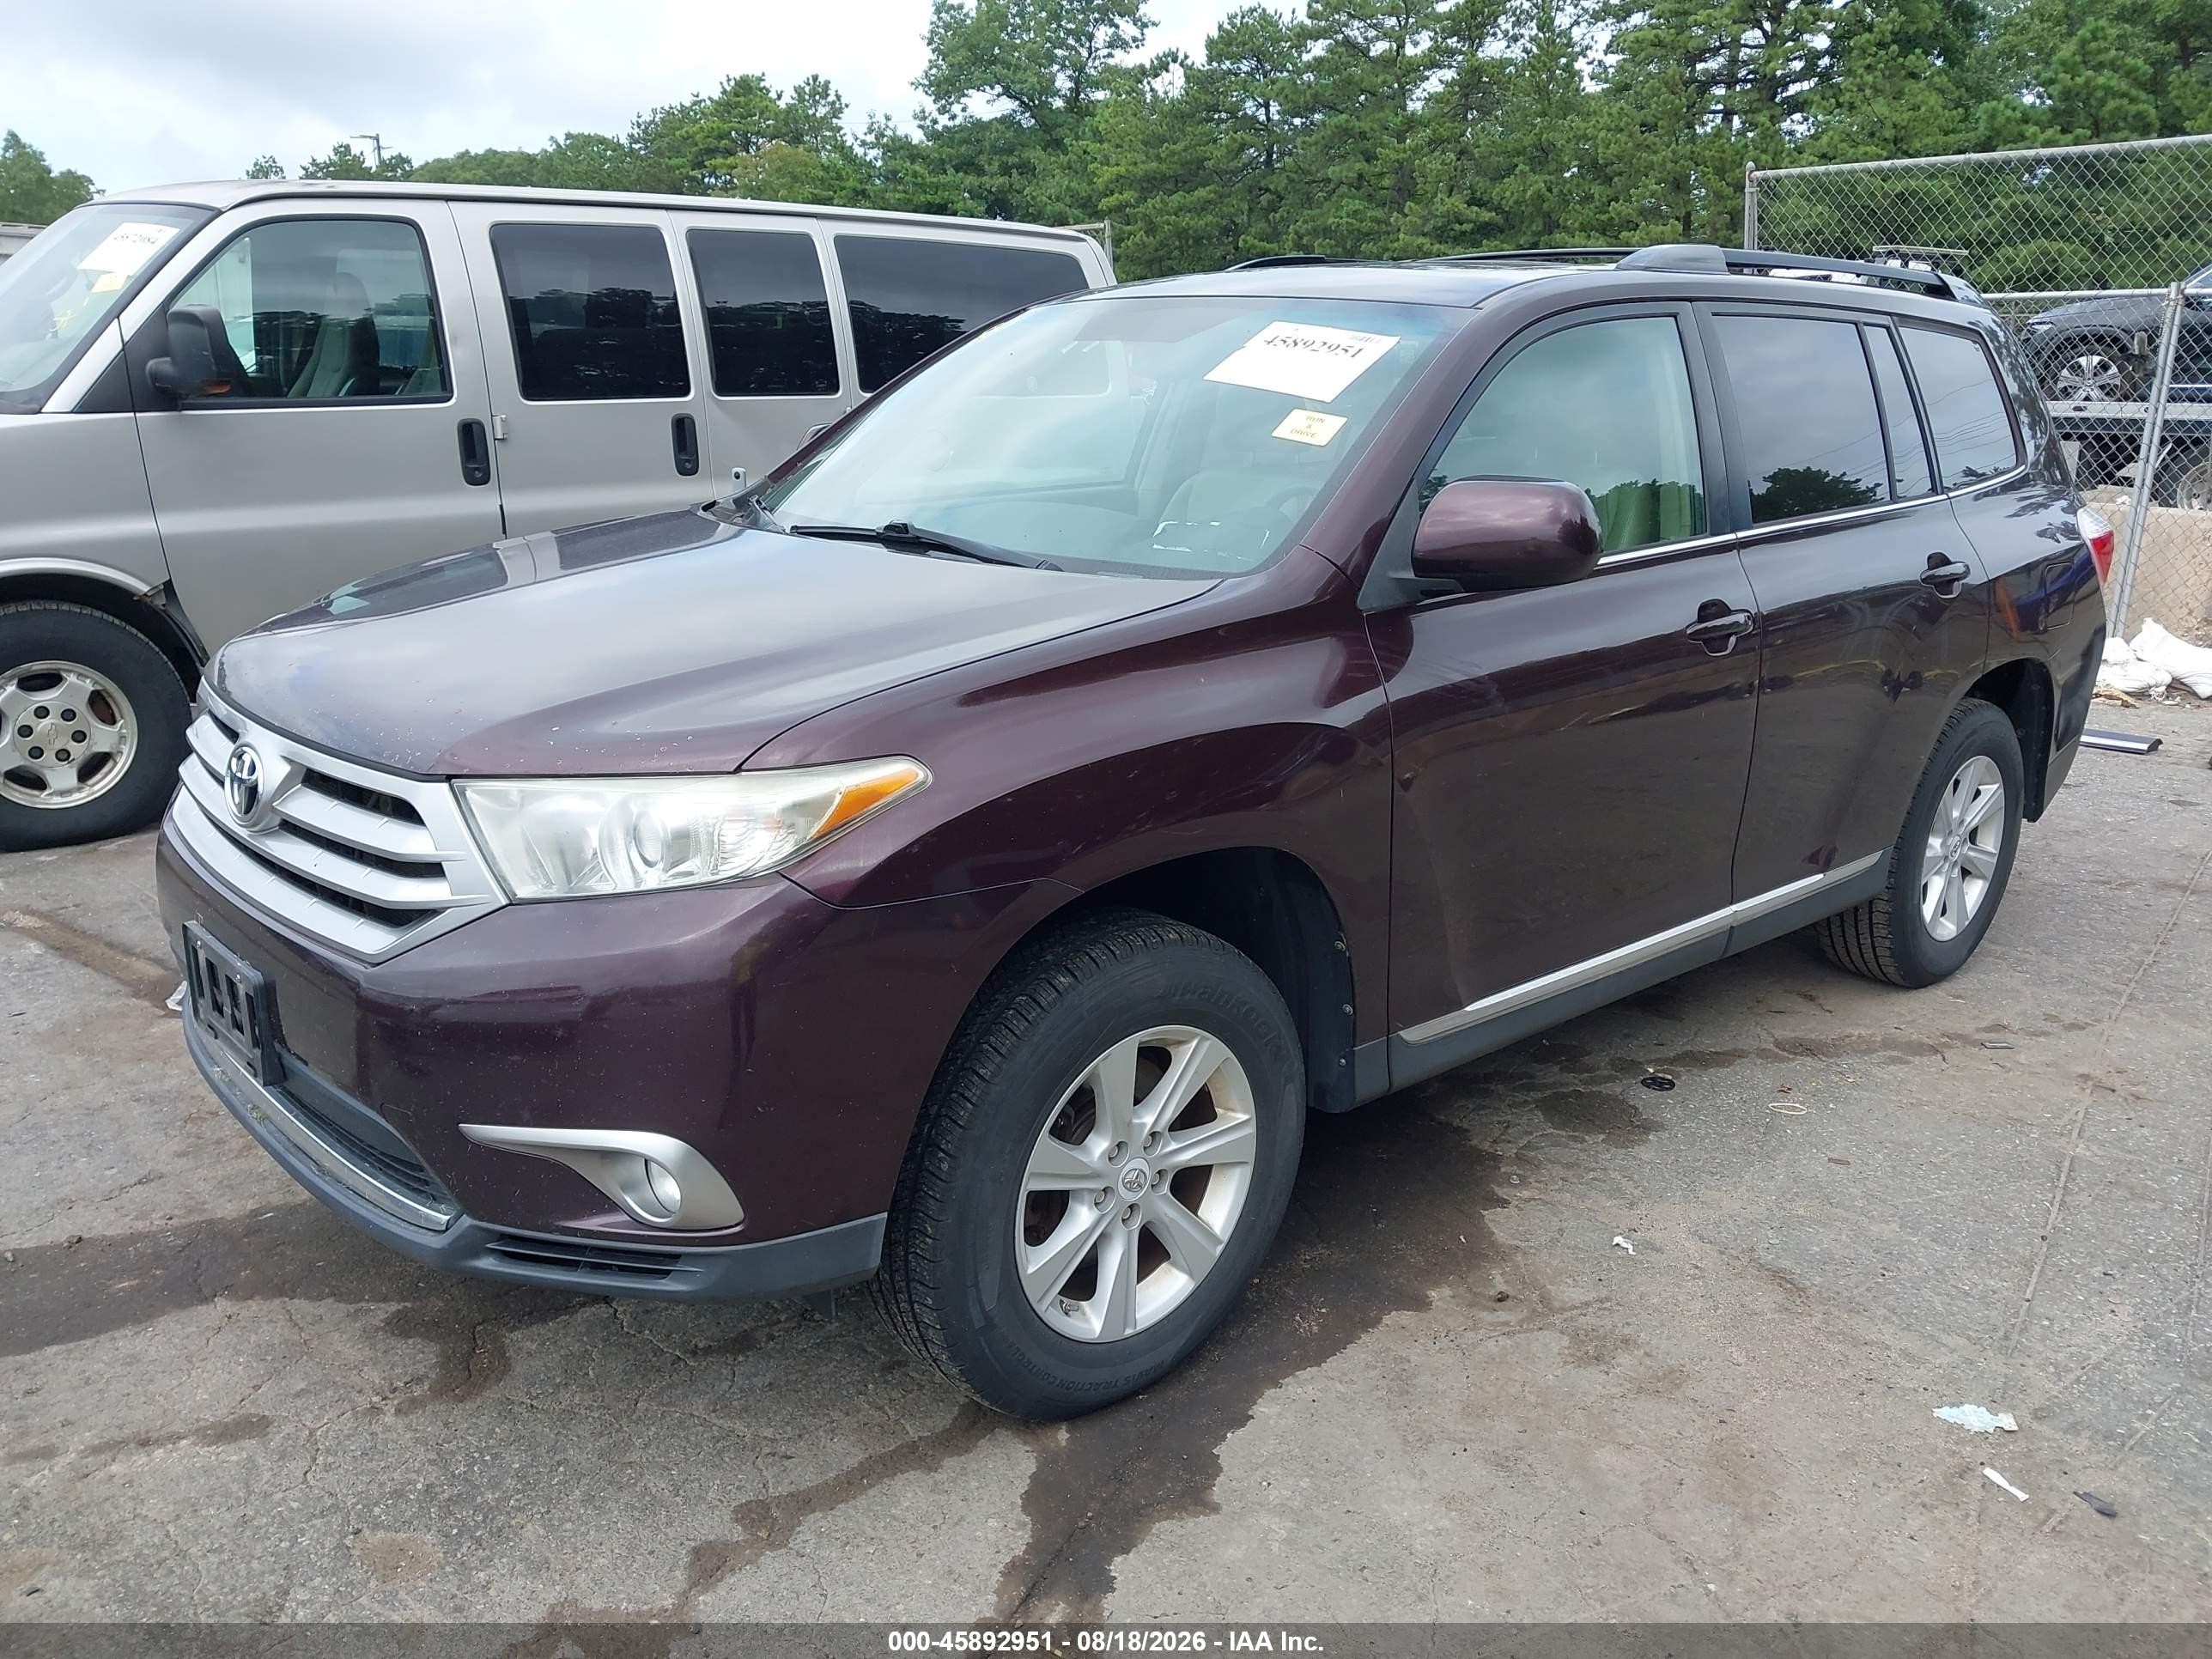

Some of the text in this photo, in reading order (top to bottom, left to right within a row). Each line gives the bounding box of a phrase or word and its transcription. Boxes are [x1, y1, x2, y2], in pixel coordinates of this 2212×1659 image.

[1264, 335, 1364, 358] 45892951
[1290, 428, 1319, 438] DRIVE
[1011, 1346, 1060, 1387] CONTROL
[1057, 1379, 1120, 1392] TRACTION
